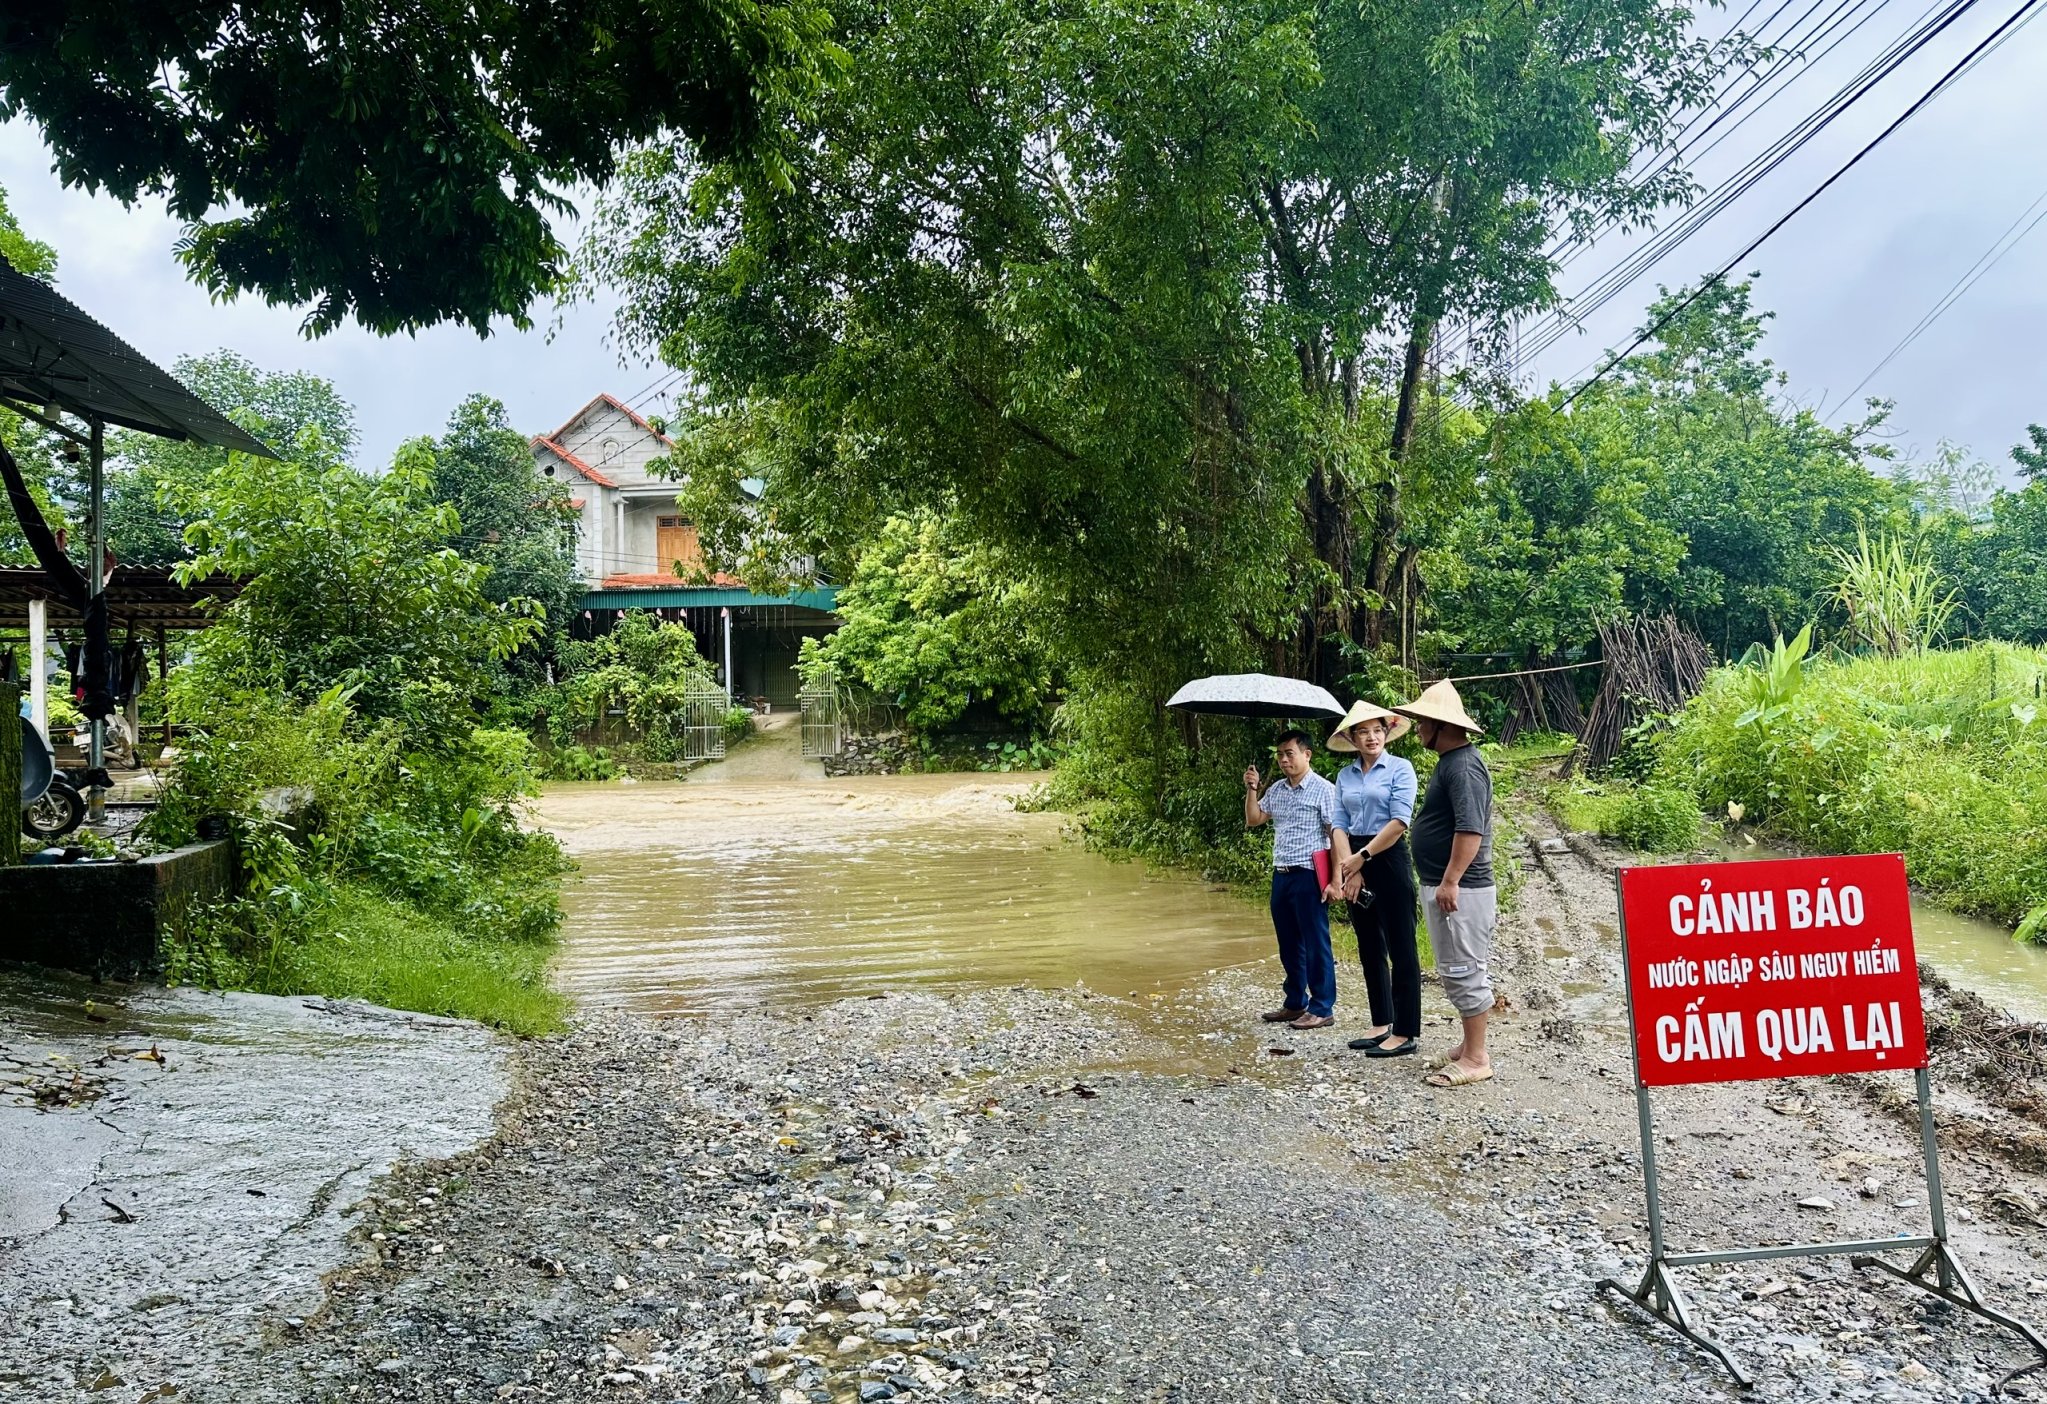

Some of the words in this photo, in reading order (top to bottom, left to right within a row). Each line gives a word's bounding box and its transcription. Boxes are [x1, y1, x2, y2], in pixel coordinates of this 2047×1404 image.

[1669, 878, 1777, 937] CẢNH
[1786, 877, 1865, 930] BÁO
[1648, 955, 1699, 989] NƯỚC
[1703, 952, 1754, 989] NGẬP
[1758, 950, 1796, 982] SÂU
[1799, 951, 1848, 979] NGUY
[1852, 937, 1901, 976] HIỂM
[1655, 996, 1746, 1063] CẤM
[1756, 1006, 1835, 1062] QUA
[1842, 1001, 1904, 1060] LẠI
